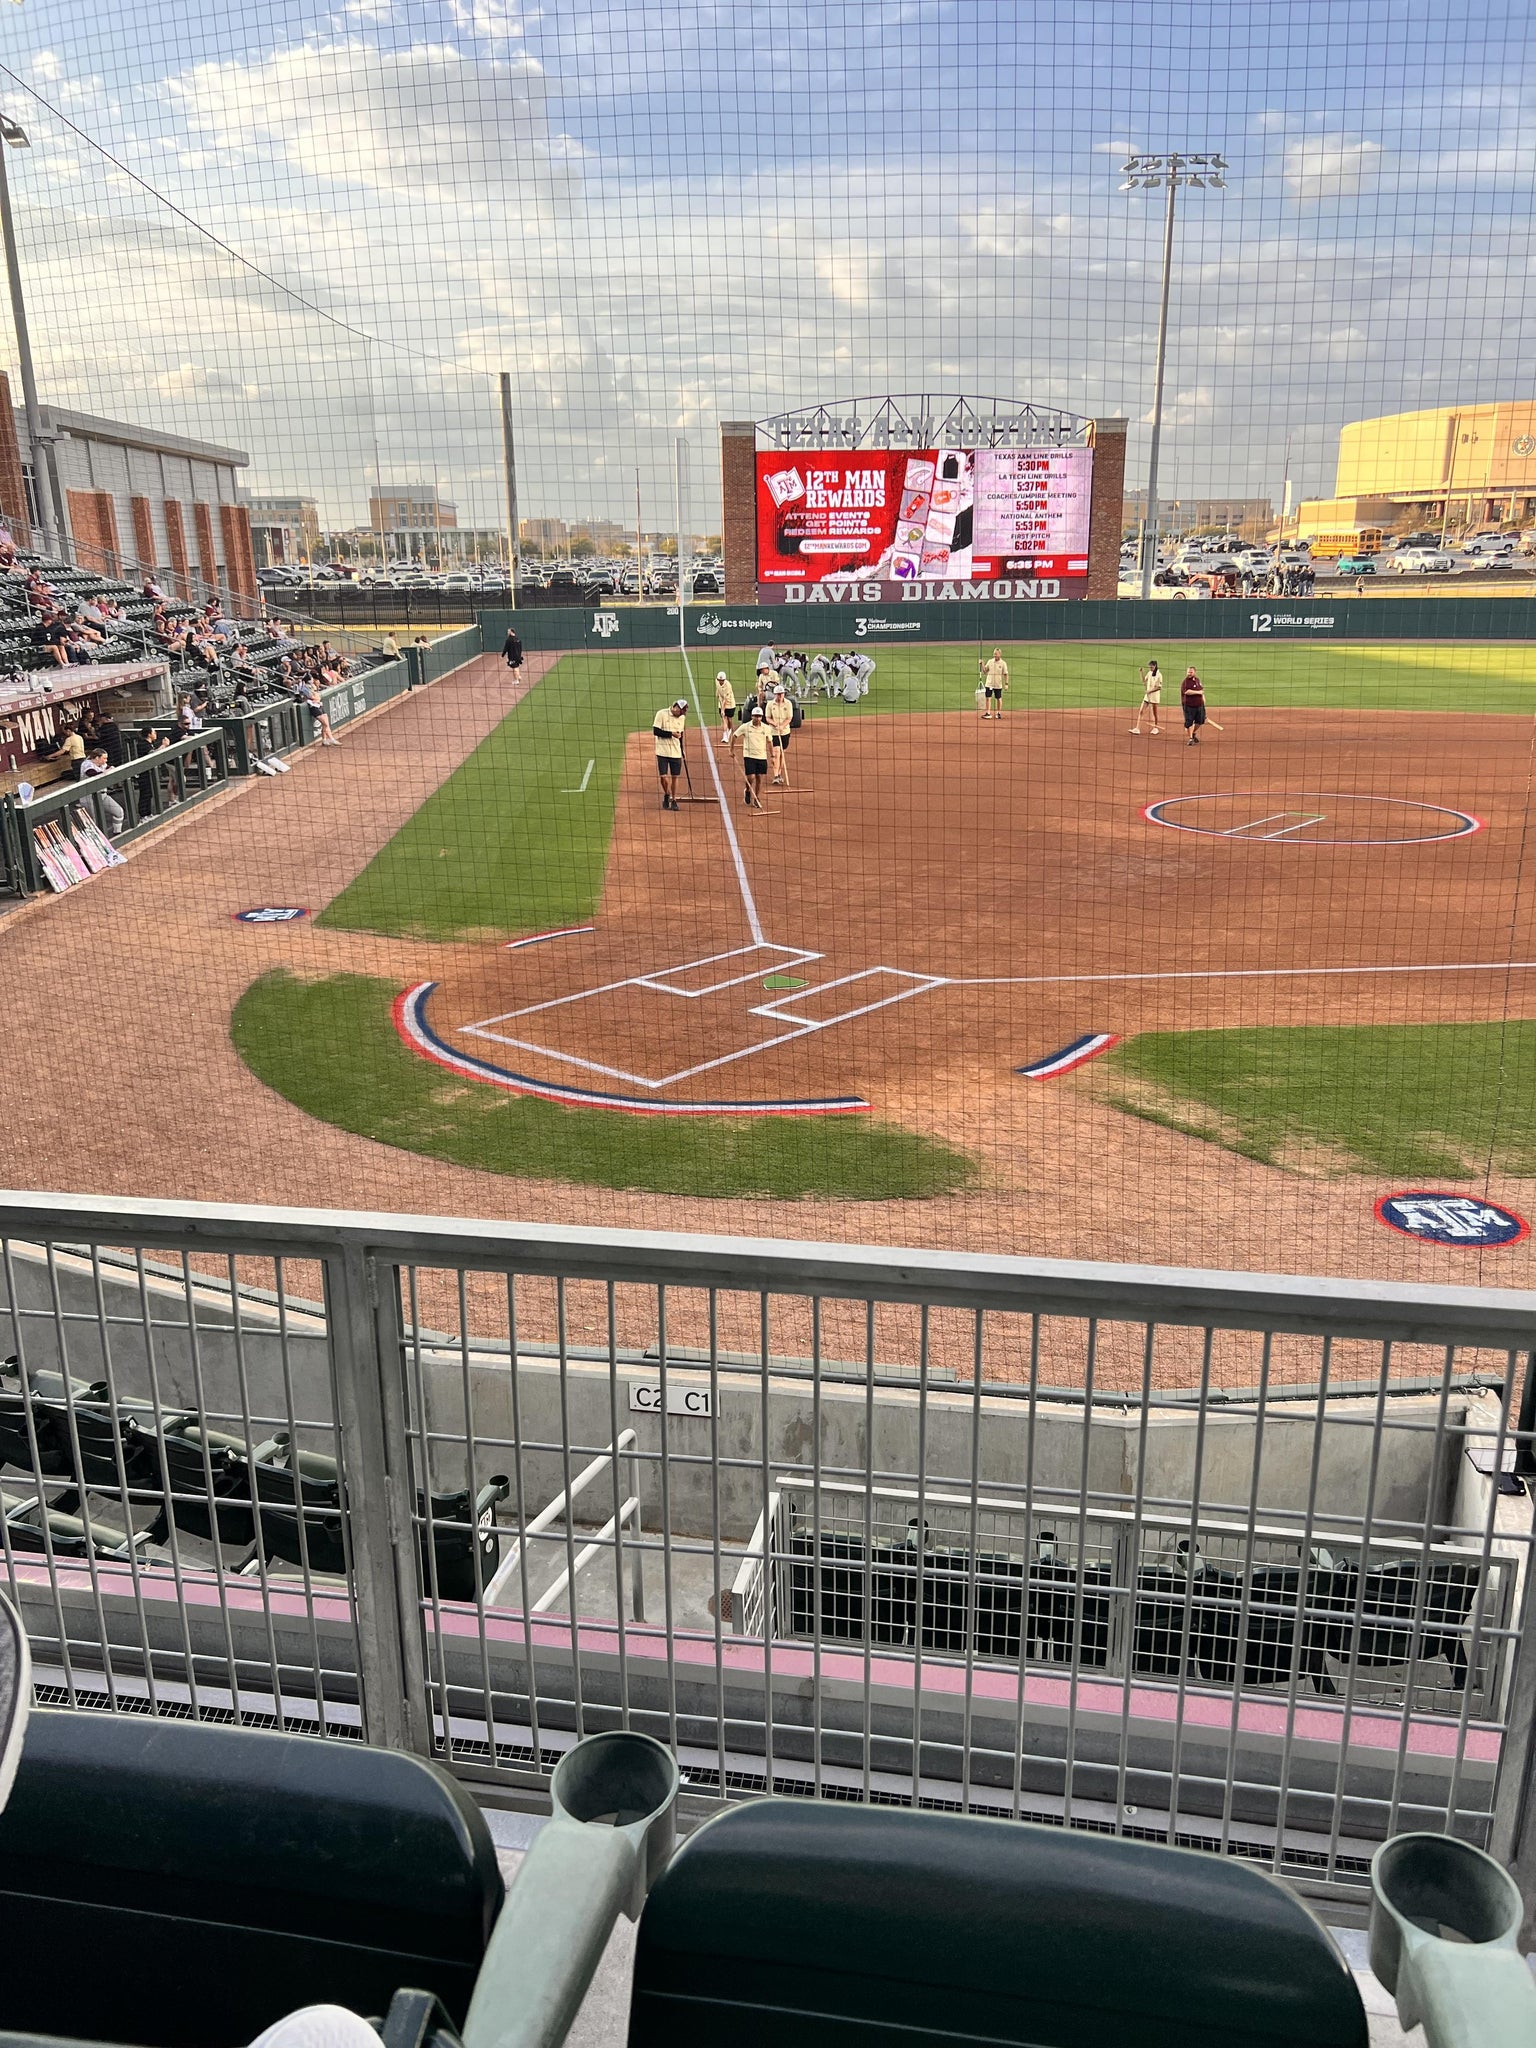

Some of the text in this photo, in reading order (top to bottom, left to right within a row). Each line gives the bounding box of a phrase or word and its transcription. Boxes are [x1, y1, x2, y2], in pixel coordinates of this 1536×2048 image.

[768, 415, 1086, 448] TEXAS A&M SOFTBALL
[1018, 460, 1049, 471] 5:30 PM
[806, 470, 885, 490] 12TH MAN
[1017, 481, 1048, 491] 5:37 PM
[806, 490, 886, 508] REWARDS
[1016, 500, 1048, 510] 5:50 PM
[785, 512, 826, 520] ATTEND
[1016, 520, 1046, 530] 5:53 PM
[784, 527, 881, 536] REDEEM REWARDS
[1014, 540, 1046, 550] 6:02 PM
[1034, 560, 1054, 568] PM
[784, 580, 1060, 603] DAVIS DIAMOND
[666, 608, 679, 616] 200
[722, 619, 772, 630] BCS Shipping
[854, 618, 868, 636] 3
[1250, 614, 1272, 632] 12
[17, 707, 56, 754] MAN
[636, 1388, 709, 1412] C2 C1
